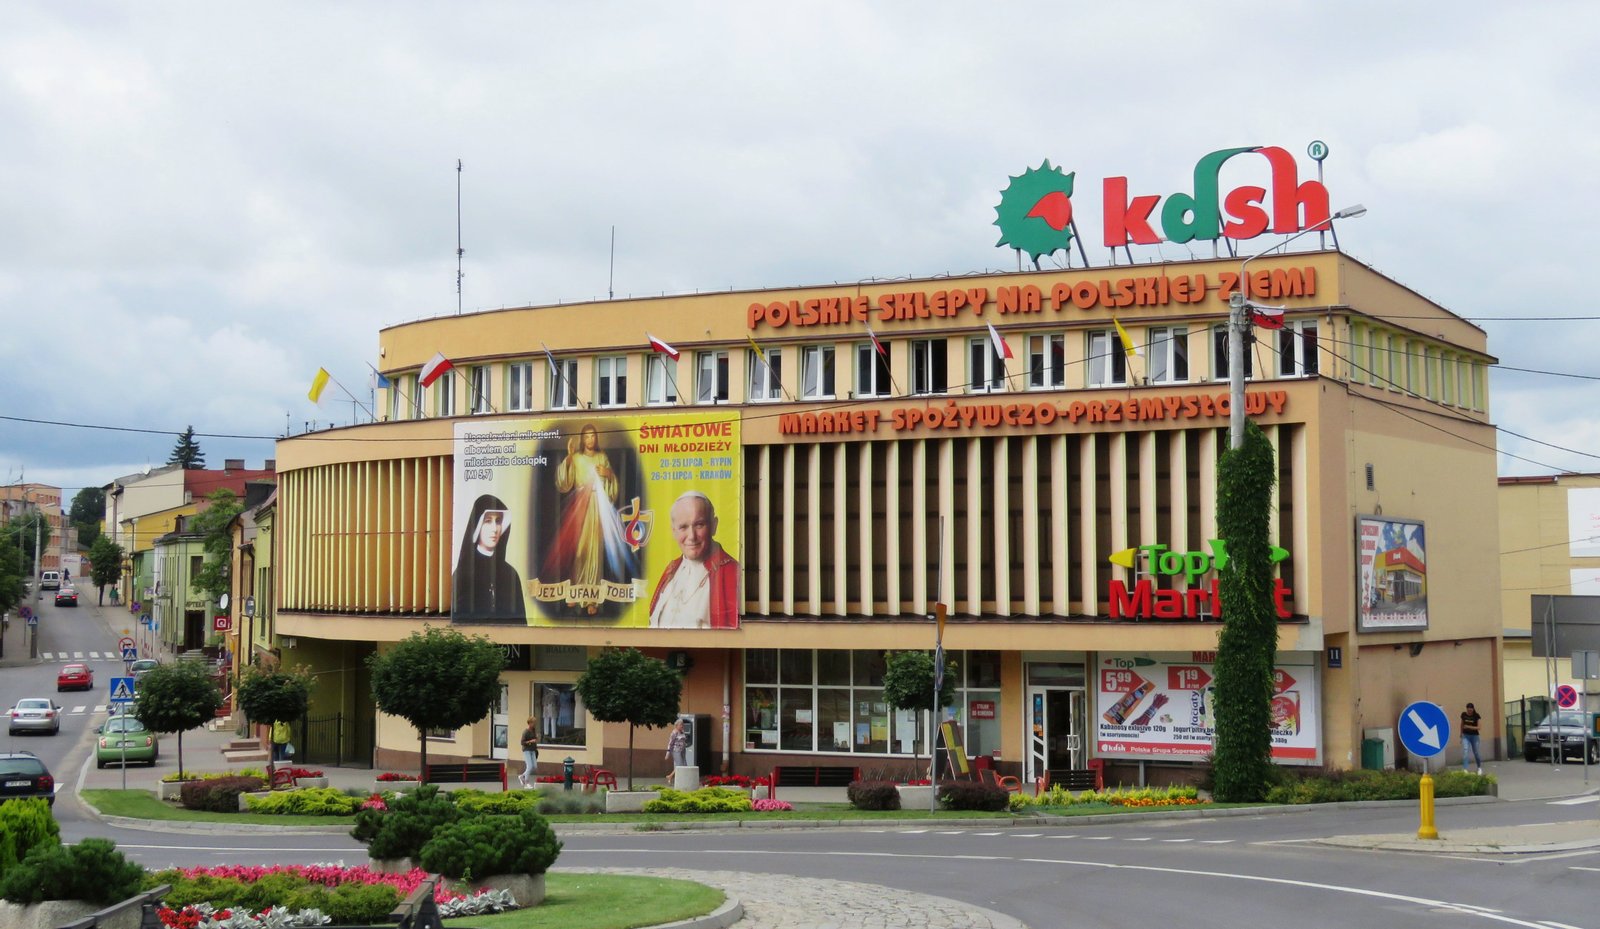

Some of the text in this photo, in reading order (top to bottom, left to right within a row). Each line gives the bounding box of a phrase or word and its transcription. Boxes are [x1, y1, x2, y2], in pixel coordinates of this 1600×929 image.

[1103, 145, 1330, 247] kdsh
[747, 266, 1315, 329] POLSKIE SKLEPY NA POLSKIEJ ZIEMI
[778, 409, 880, 434] MARKET
[639, 422, 732, 439] ŚWIATOWE
[503, 443, 516, 453] oni
[639, 440, 732, 453] DNI MŁODZIEŻY
[1139, 543, 1210, 584] Top
[538, 585, 634, 599] JEZU UFAM TOBIE
[1108, 578, 1292, 618] Mart
[1330, 649, 1339, 660] 11
[1113, 657, 1135, 670] Top
